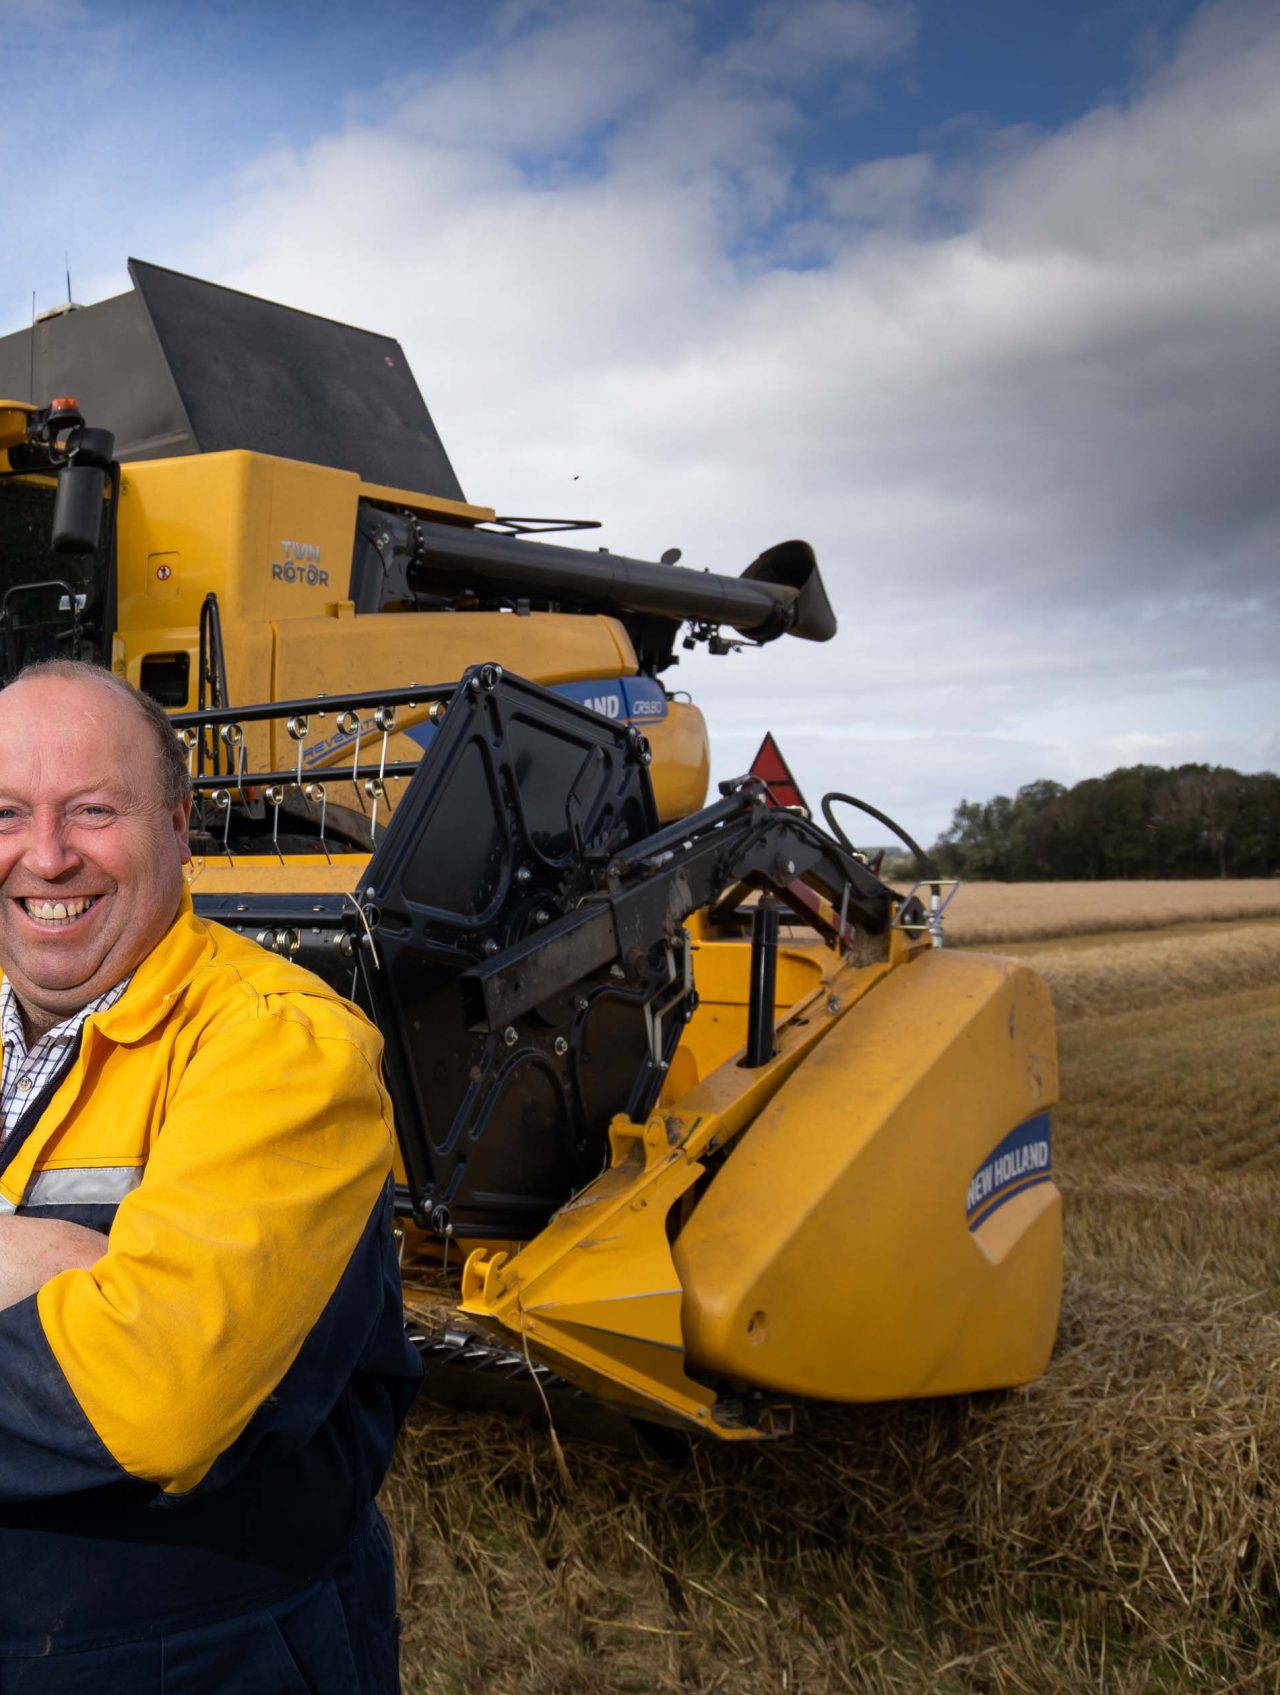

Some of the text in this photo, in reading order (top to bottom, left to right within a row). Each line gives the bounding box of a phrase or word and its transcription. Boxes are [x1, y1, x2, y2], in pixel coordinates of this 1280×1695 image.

[280, 540, 321, 562] TWIN
[966, 1141, 1048, 1210] NEW HOLLAND
